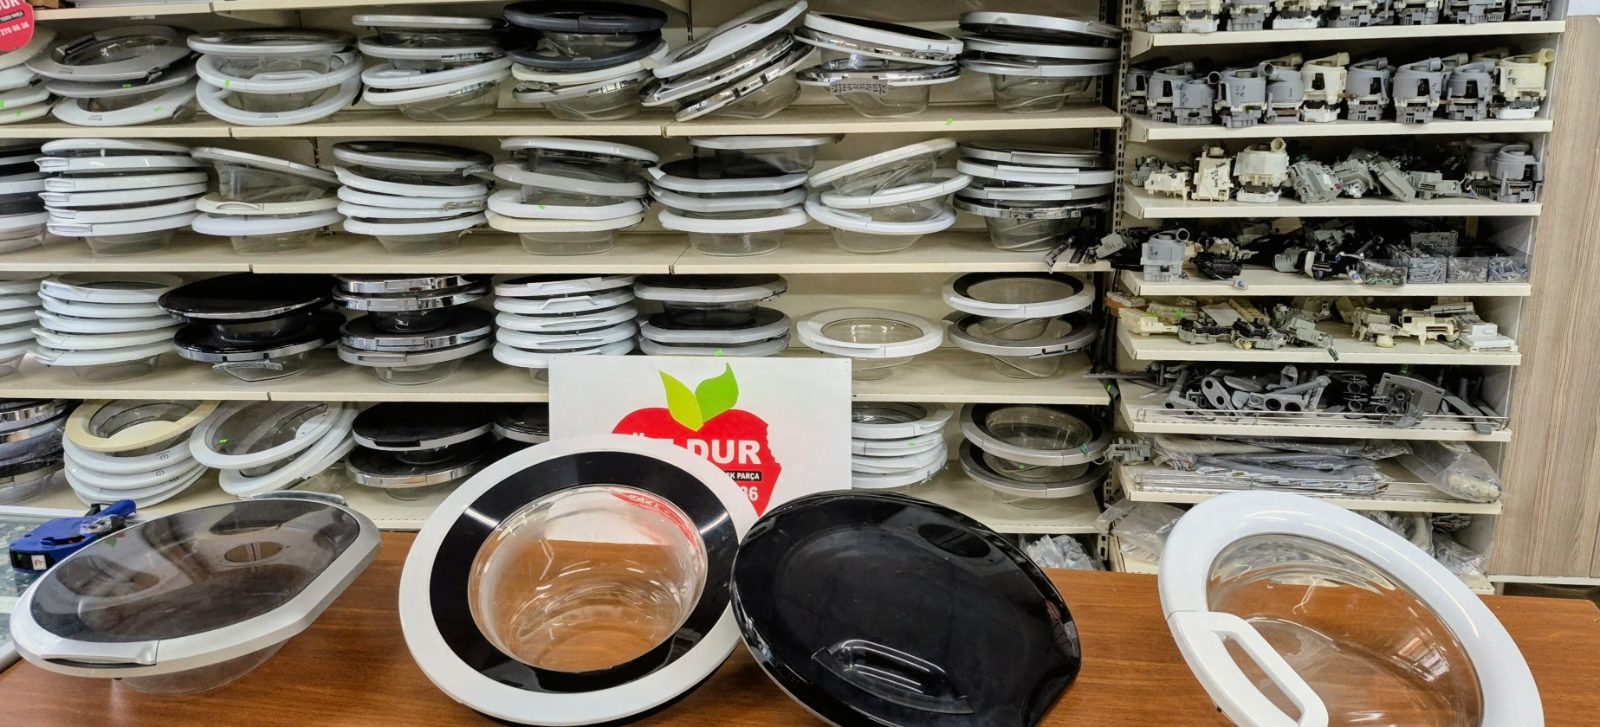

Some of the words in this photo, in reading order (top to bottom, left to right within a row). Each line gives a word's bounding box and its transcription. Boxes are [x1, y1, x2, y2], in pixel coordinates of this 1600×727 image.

[0, 0, 21, 10] UR
[687, 439, 762, 464] DUR
[736, 472, 760, 481] PARÇA
